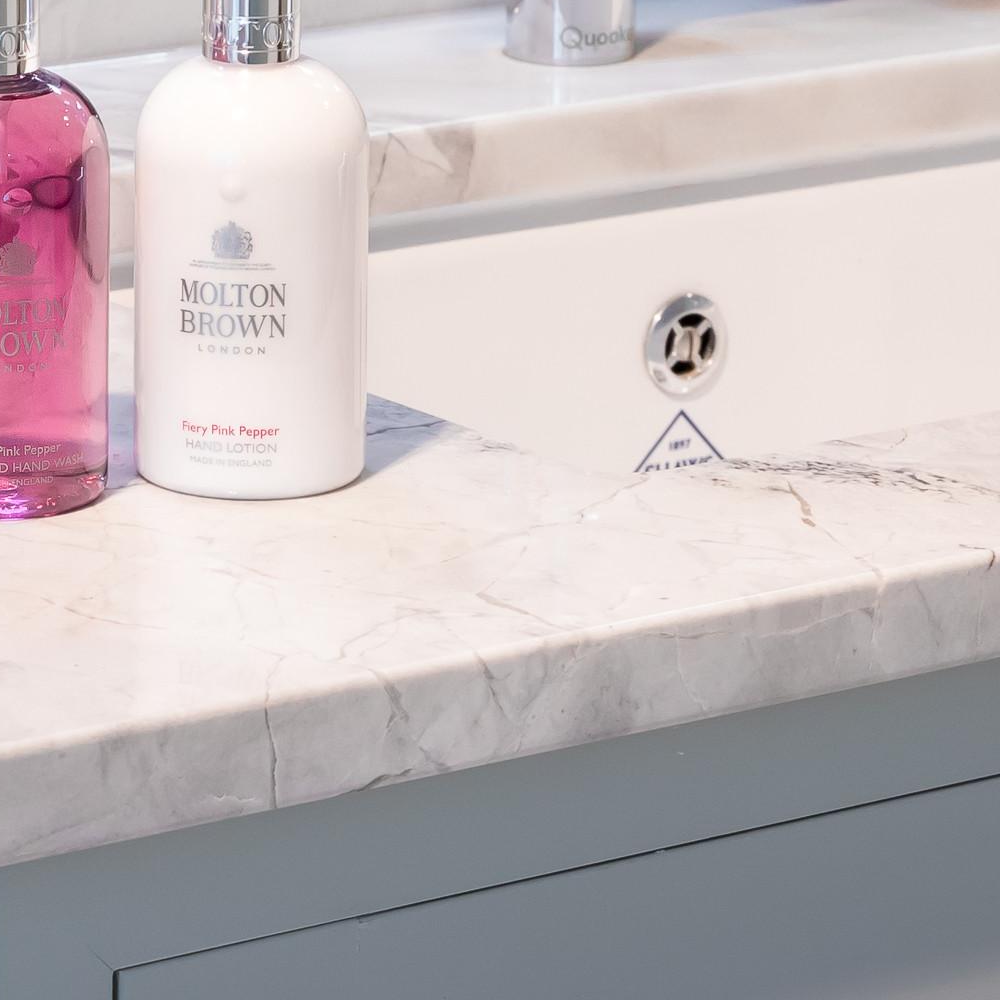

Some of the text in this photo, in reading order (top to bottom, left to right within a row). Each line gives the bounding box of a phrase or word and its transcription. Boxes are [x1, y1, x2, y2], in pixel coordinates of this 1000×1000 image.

[180, 278, 287, 308] MOLTON
[180, 308, 287, 338] BROWN
[197, 343, 266, 355] LONDON
[182, 420, 280, 439] Fiery Pink Pepper
[24, 442, 62, 456] Pepper
[185, 438, 278, 454] HAND LOTION
[12, 459, 50, 473] HAND
[54, 452, 84, 468] WASH
[190, 455, 272, 468] MADE IN ENGLAND
[11, 475, 54, 486] ENGLAND
